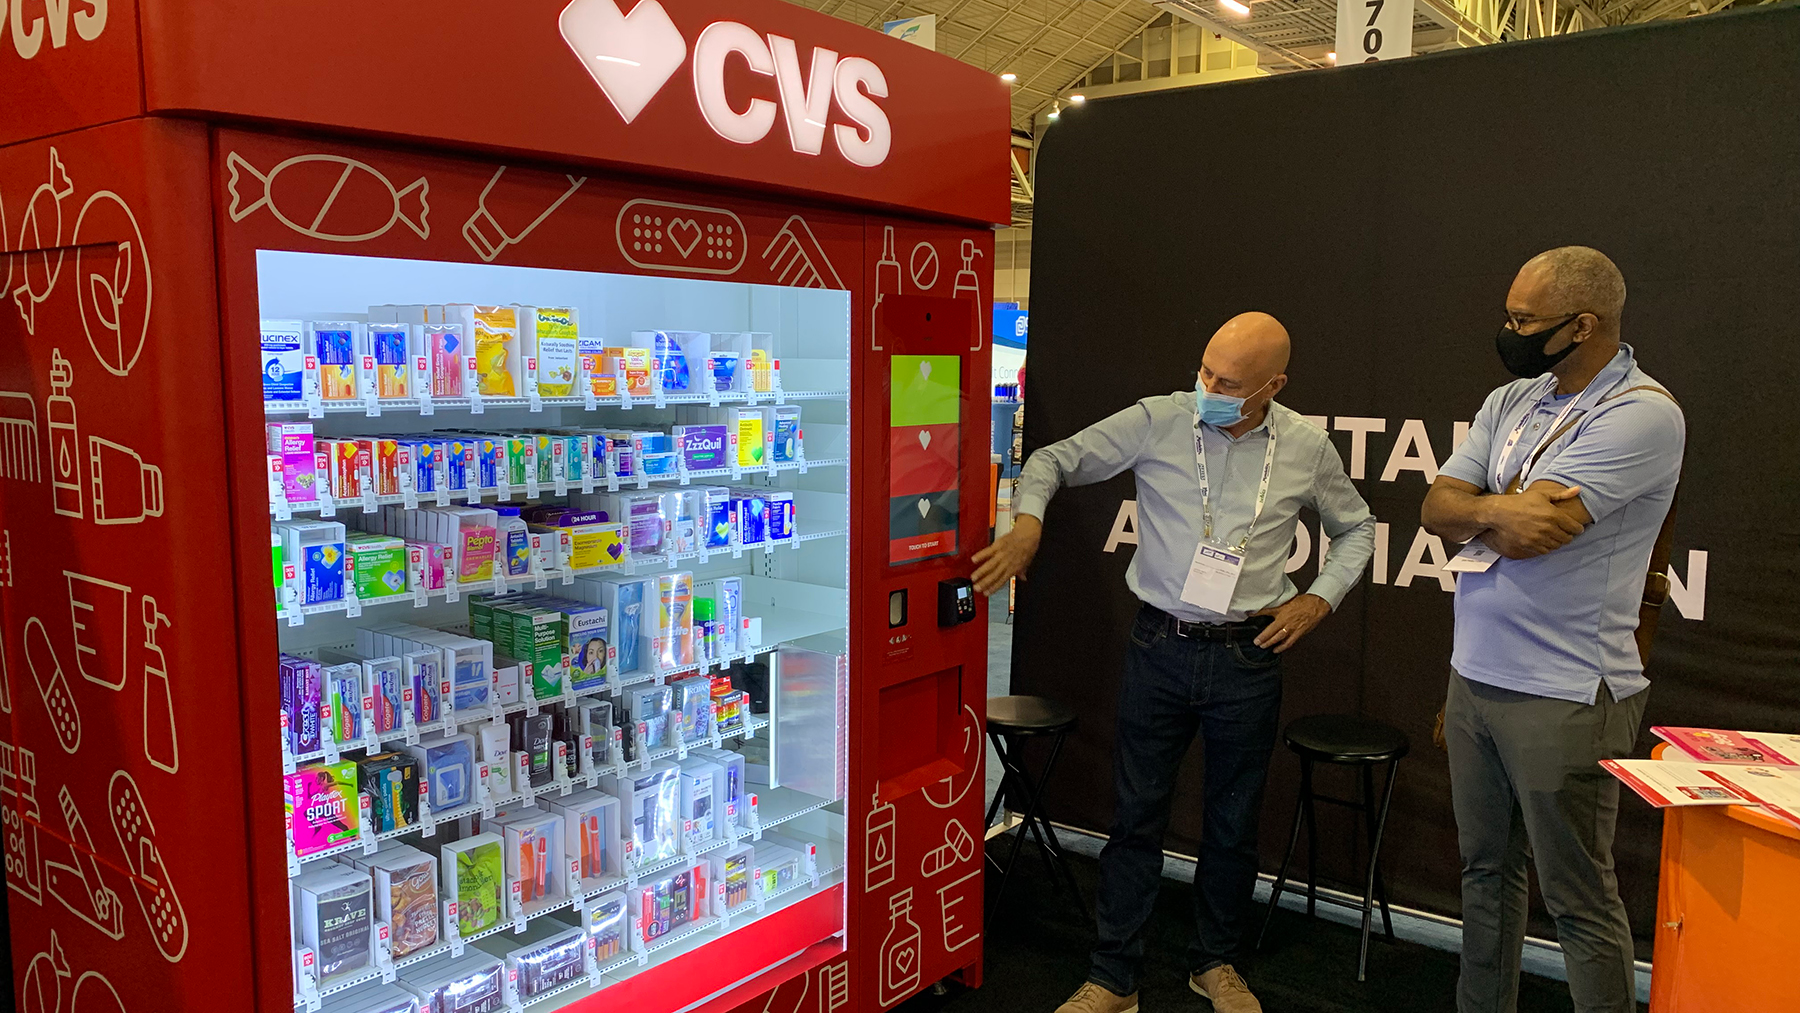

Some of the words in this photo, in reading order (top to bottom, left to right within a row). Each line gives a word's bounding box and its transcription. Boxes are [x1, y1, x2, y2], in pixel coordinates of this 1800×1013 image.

[693, 21, 891, 167] CVS
[541, 341, 558, 349] Naturally
[284, 439, 306, 447] Allergy
[685, 437, 722, 451] ZzzQuil
[467, 535, 494, 548] Pepto
[927, 540, 939, 548] START
[578, 616, 606, 627] Eustachi
[534, 630, 556, 638] Purpose
[534, 636, 556, 644] Solution
[688, 683, 710, 695] ROJAN
[422, 694, 430, 721] Colgate
[301, 707, 310, 746] Crest
[343, 711, 351, 739] Colgate
[494, 749, 508, 757] Dove
[311, 790, 343, 806] Playtex
[306, 798, 348, 822] SPORT
[323, 908, 366, 928] KRAVE
[320, 938, 331, 946] SEA
[332, 933, 345, 943] SALT
[345, 925, 370, 938] ORIGINAL
